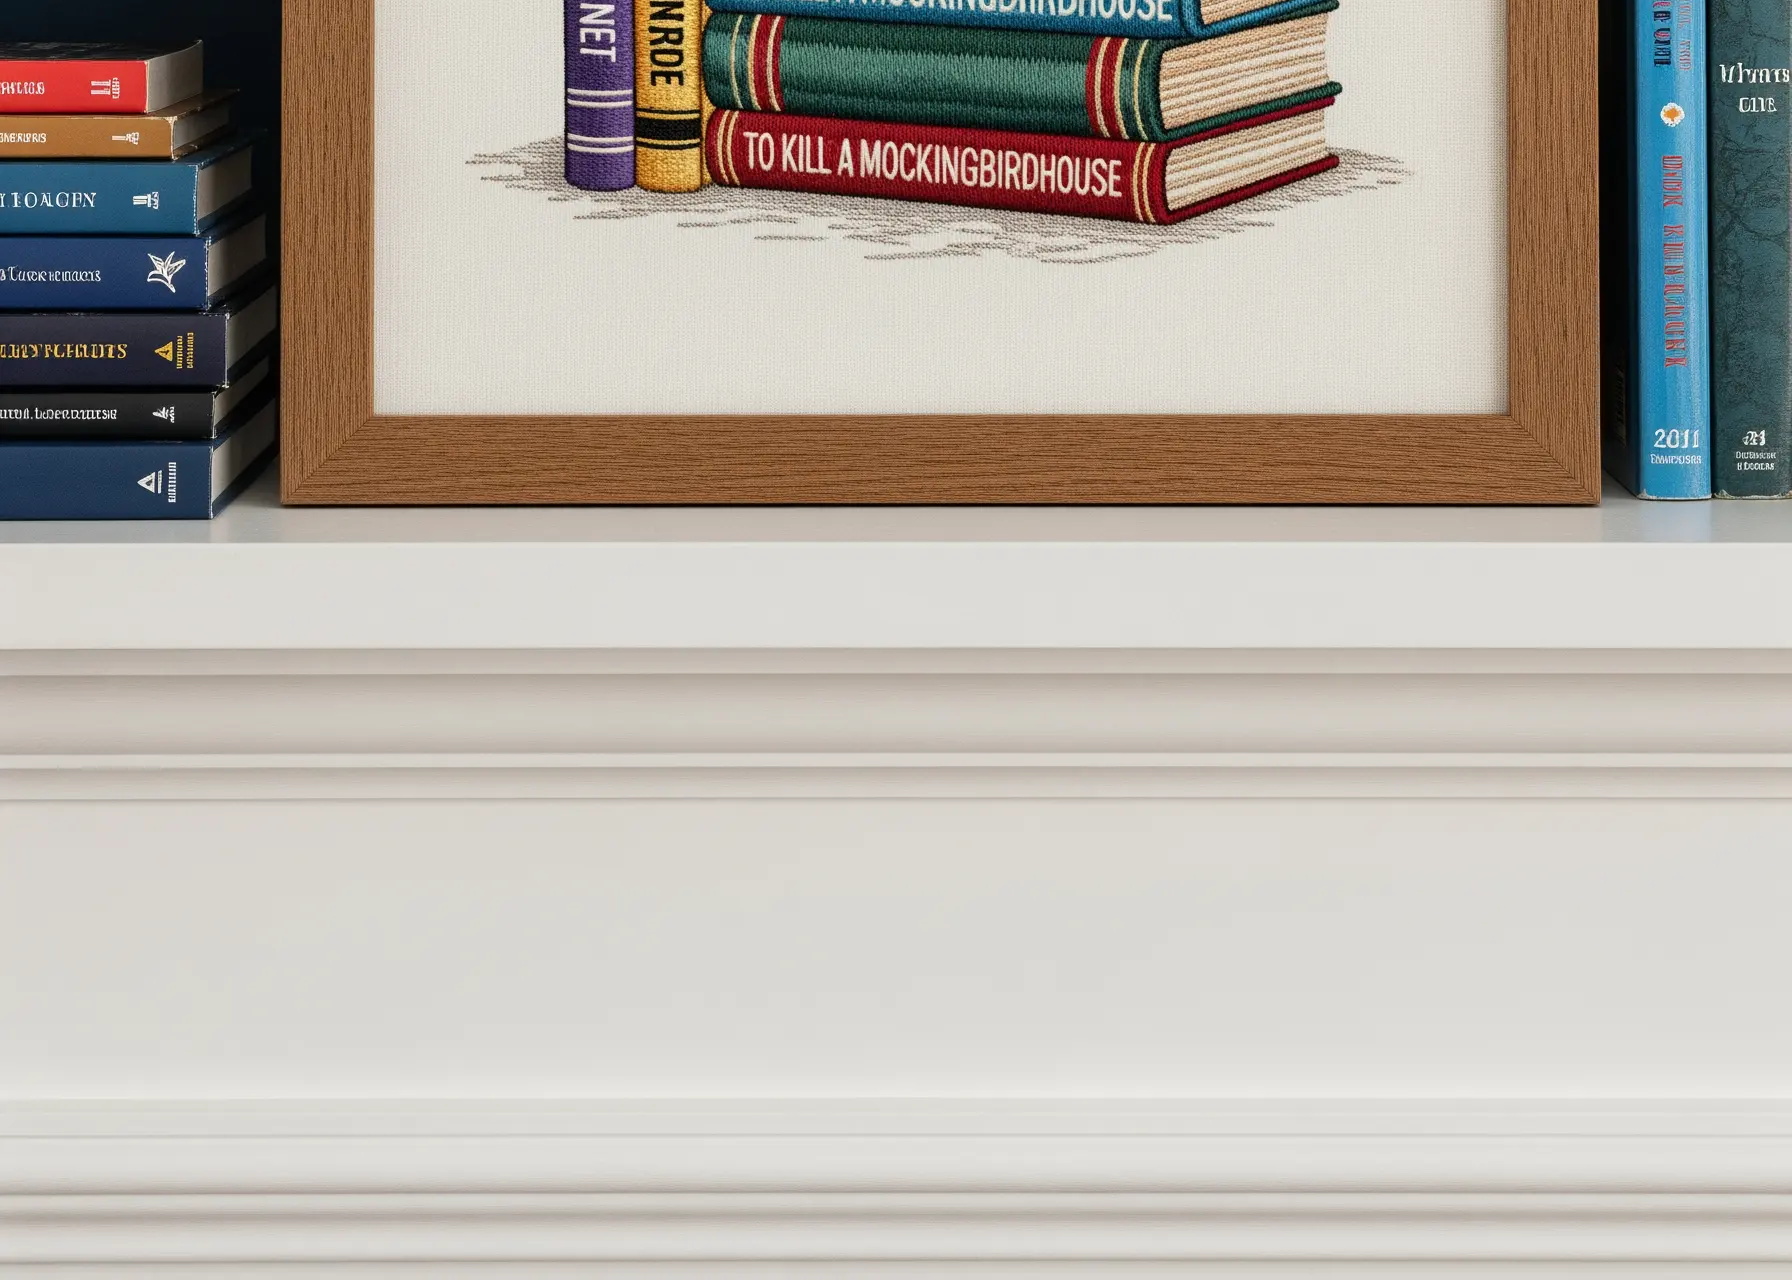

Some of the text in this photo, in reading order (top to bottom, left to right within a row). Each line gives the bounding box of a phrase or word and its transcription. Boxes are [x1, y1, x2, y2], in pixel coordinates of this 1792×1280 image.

[742, 131, 1123, 199] TO KILL A MOCKINGBIRDHOUSE
[1653, 428, 1700, 449] 2011
